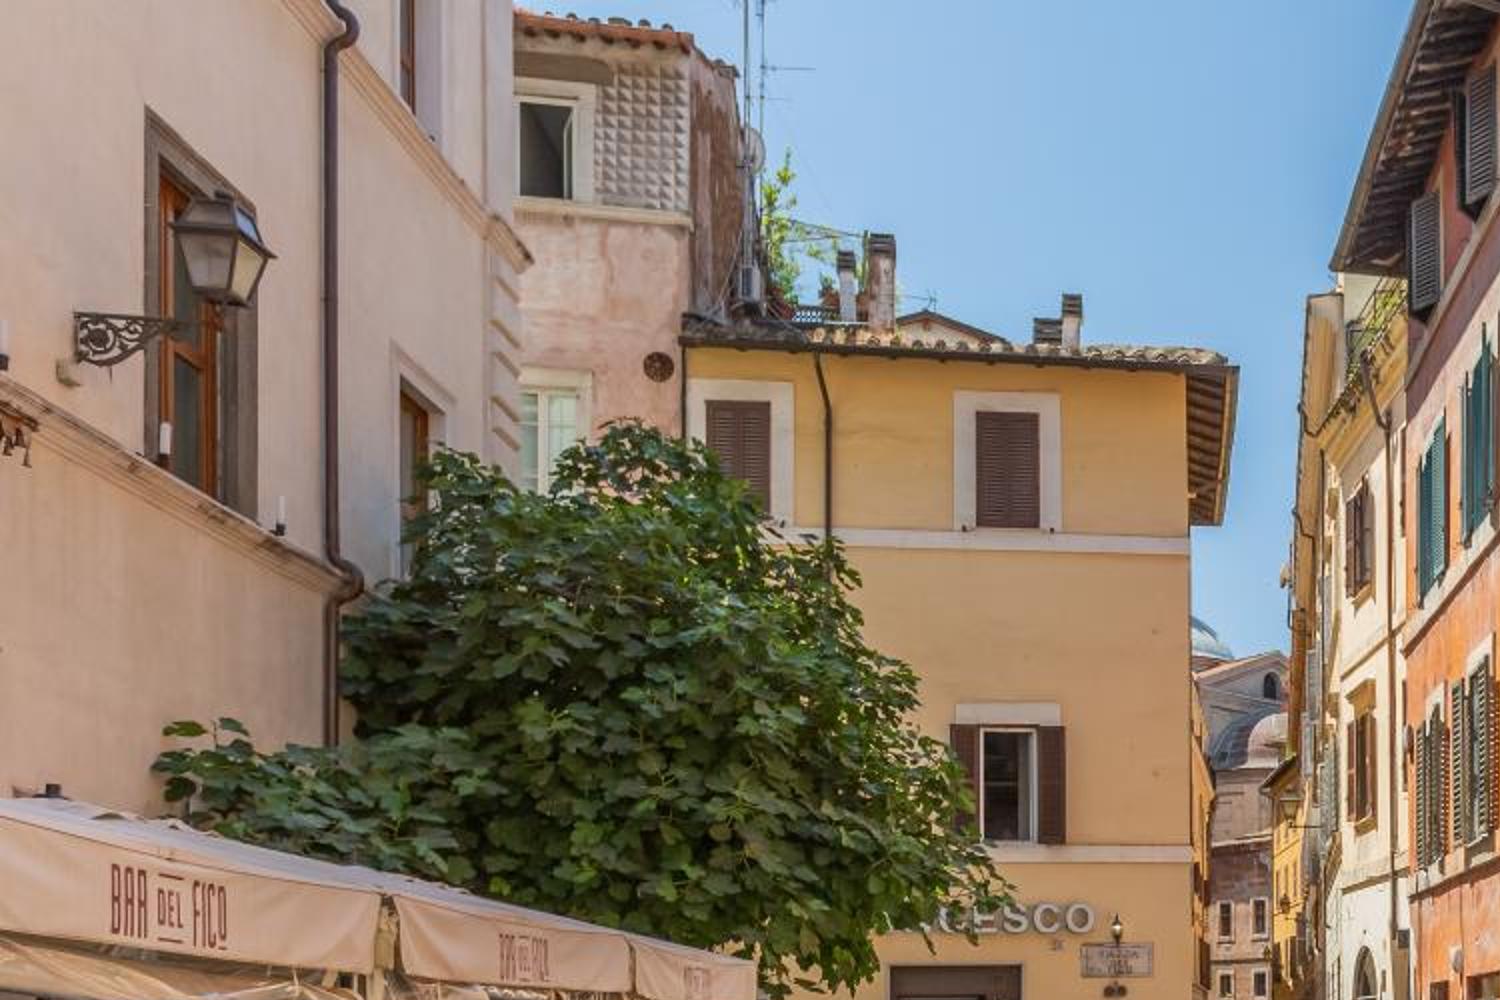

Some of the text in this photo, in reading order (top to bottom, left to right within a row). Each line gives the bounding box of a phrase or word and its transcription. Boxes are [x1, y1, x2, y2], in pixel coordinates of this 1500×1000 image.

[111, 863, 227, 950] BAR DEL FICO
[881, 902, 1095, 933] CESCO
